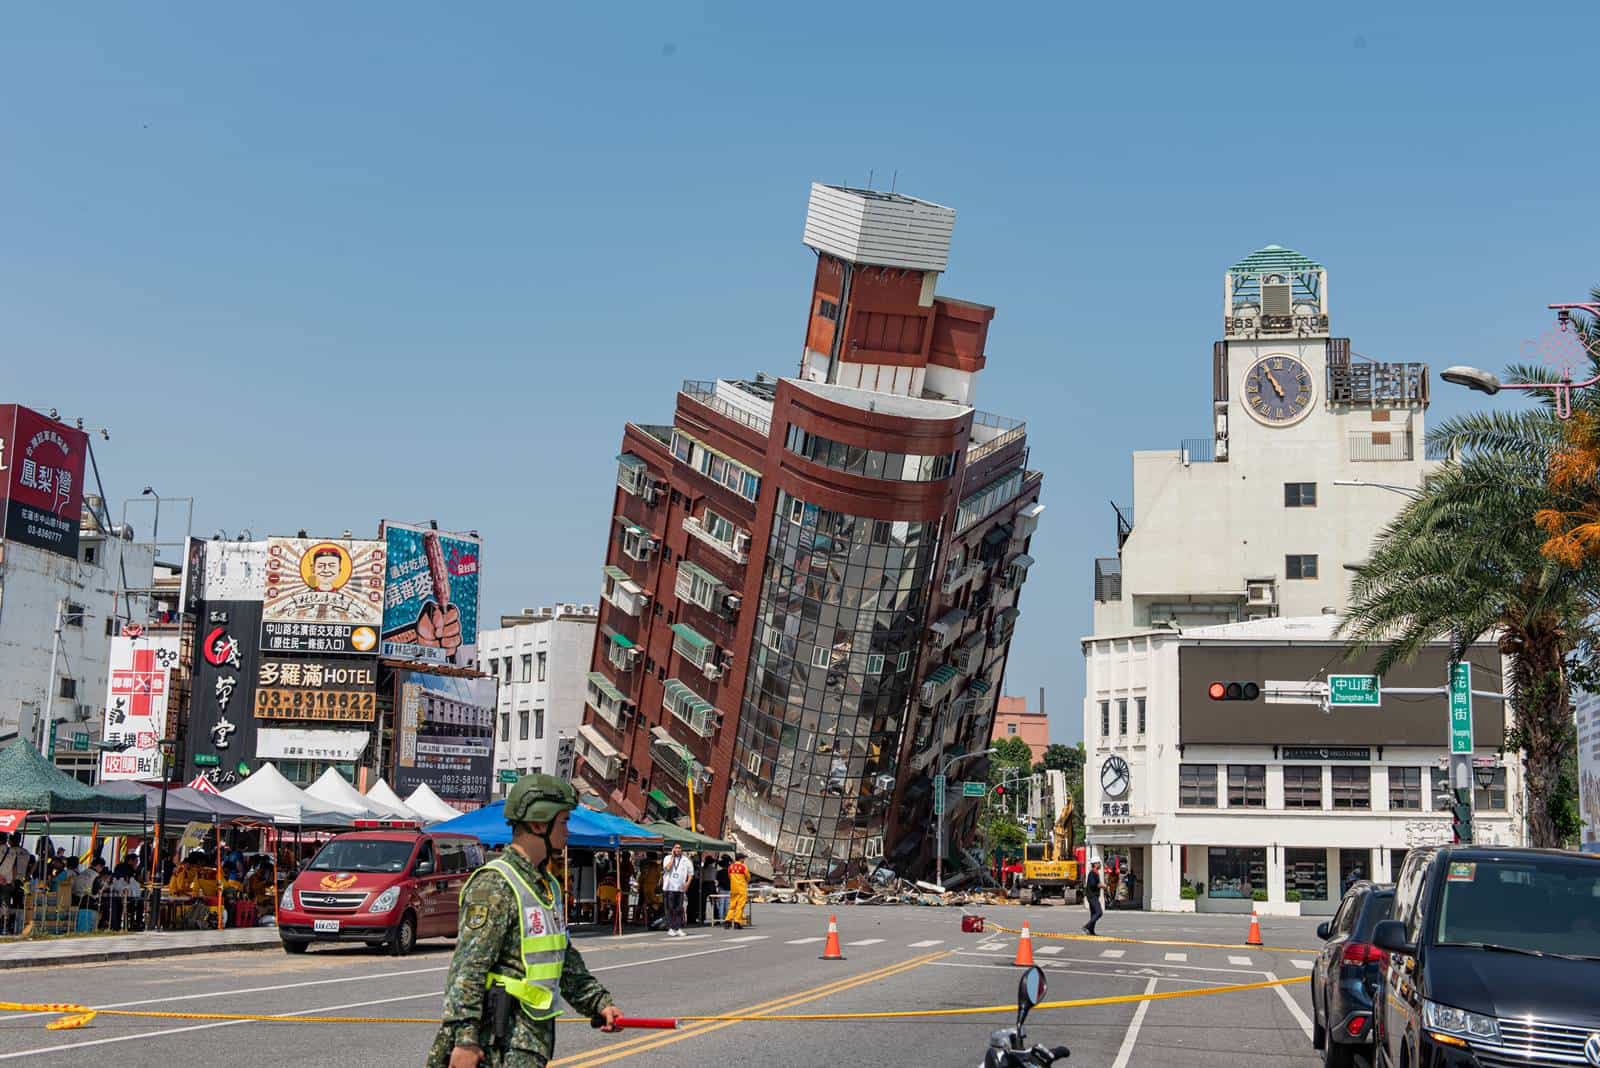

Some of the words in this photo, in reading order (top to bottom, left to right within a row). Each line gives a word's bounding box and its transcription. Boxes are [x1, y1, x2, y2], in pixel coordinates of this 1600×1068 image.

[20, 458, 72, 514] 鳳梨灣
[258, 663, 323, 687] 多羅滿
[324, 668, 375, 684] HOTEL
[1336, 679, 1375, 690] 中山路
